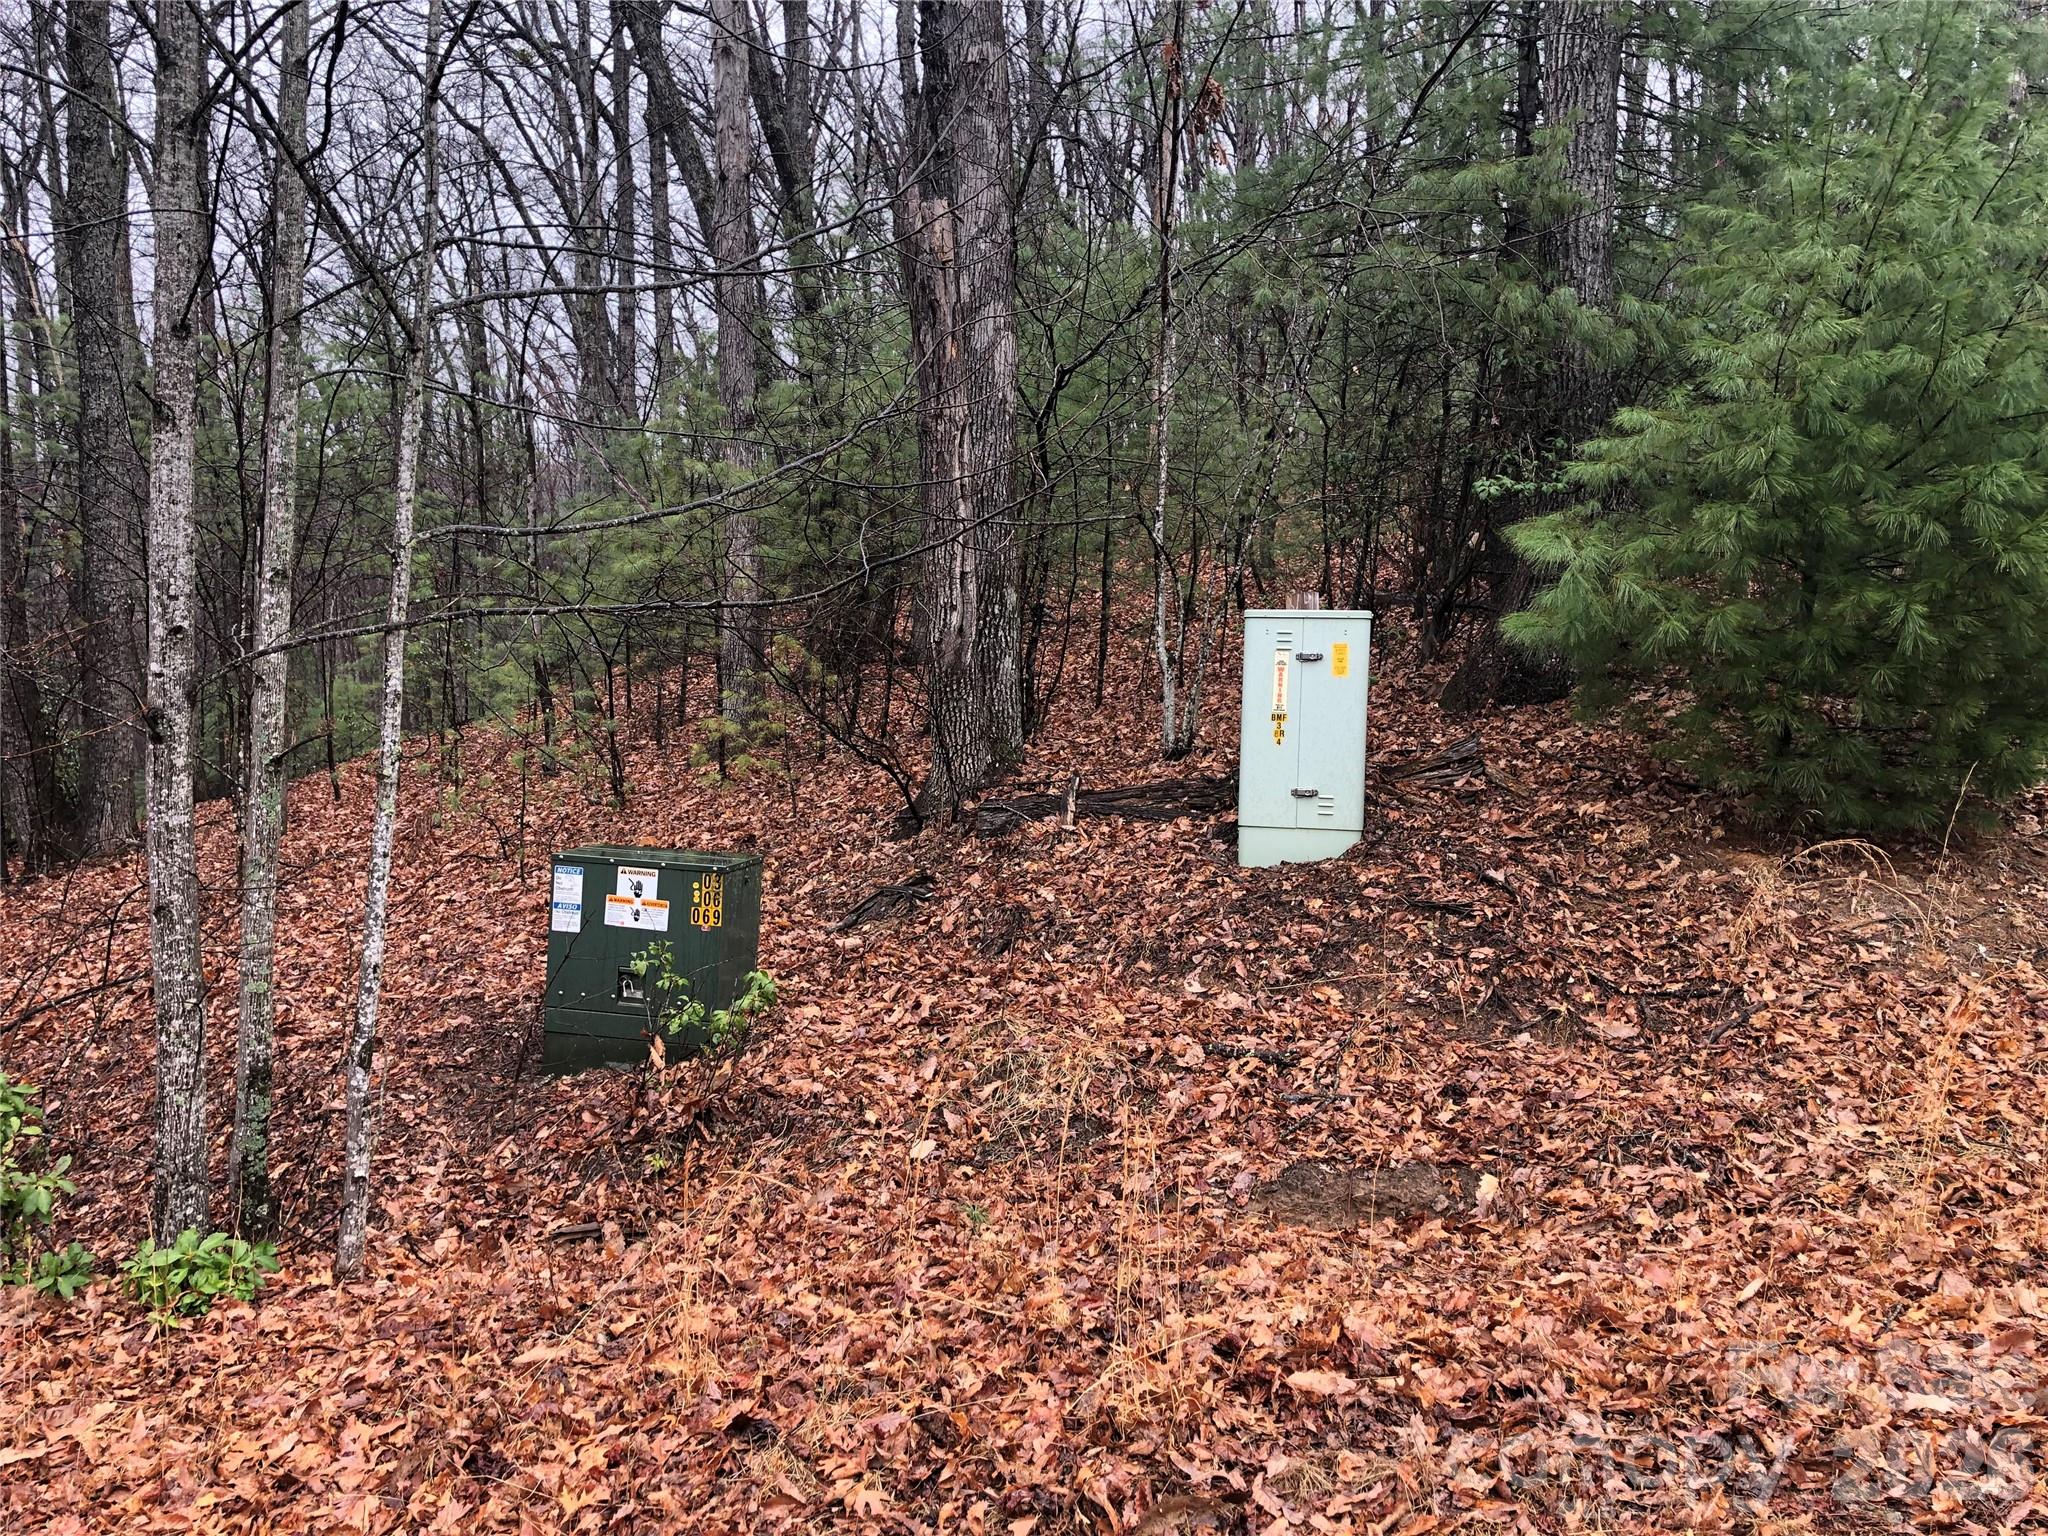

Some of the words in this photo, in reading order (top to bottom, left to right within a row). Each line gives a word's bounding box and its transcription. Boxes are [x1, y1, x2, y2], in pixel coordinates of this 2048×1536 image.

[1271, 713, 1287, 721] BMF
[627, 870, 656, 878] WARNING
[703, 874, 721, 890] 03
[703, 891, 721, 907] 06
[692, 907, 721, 925] 069
